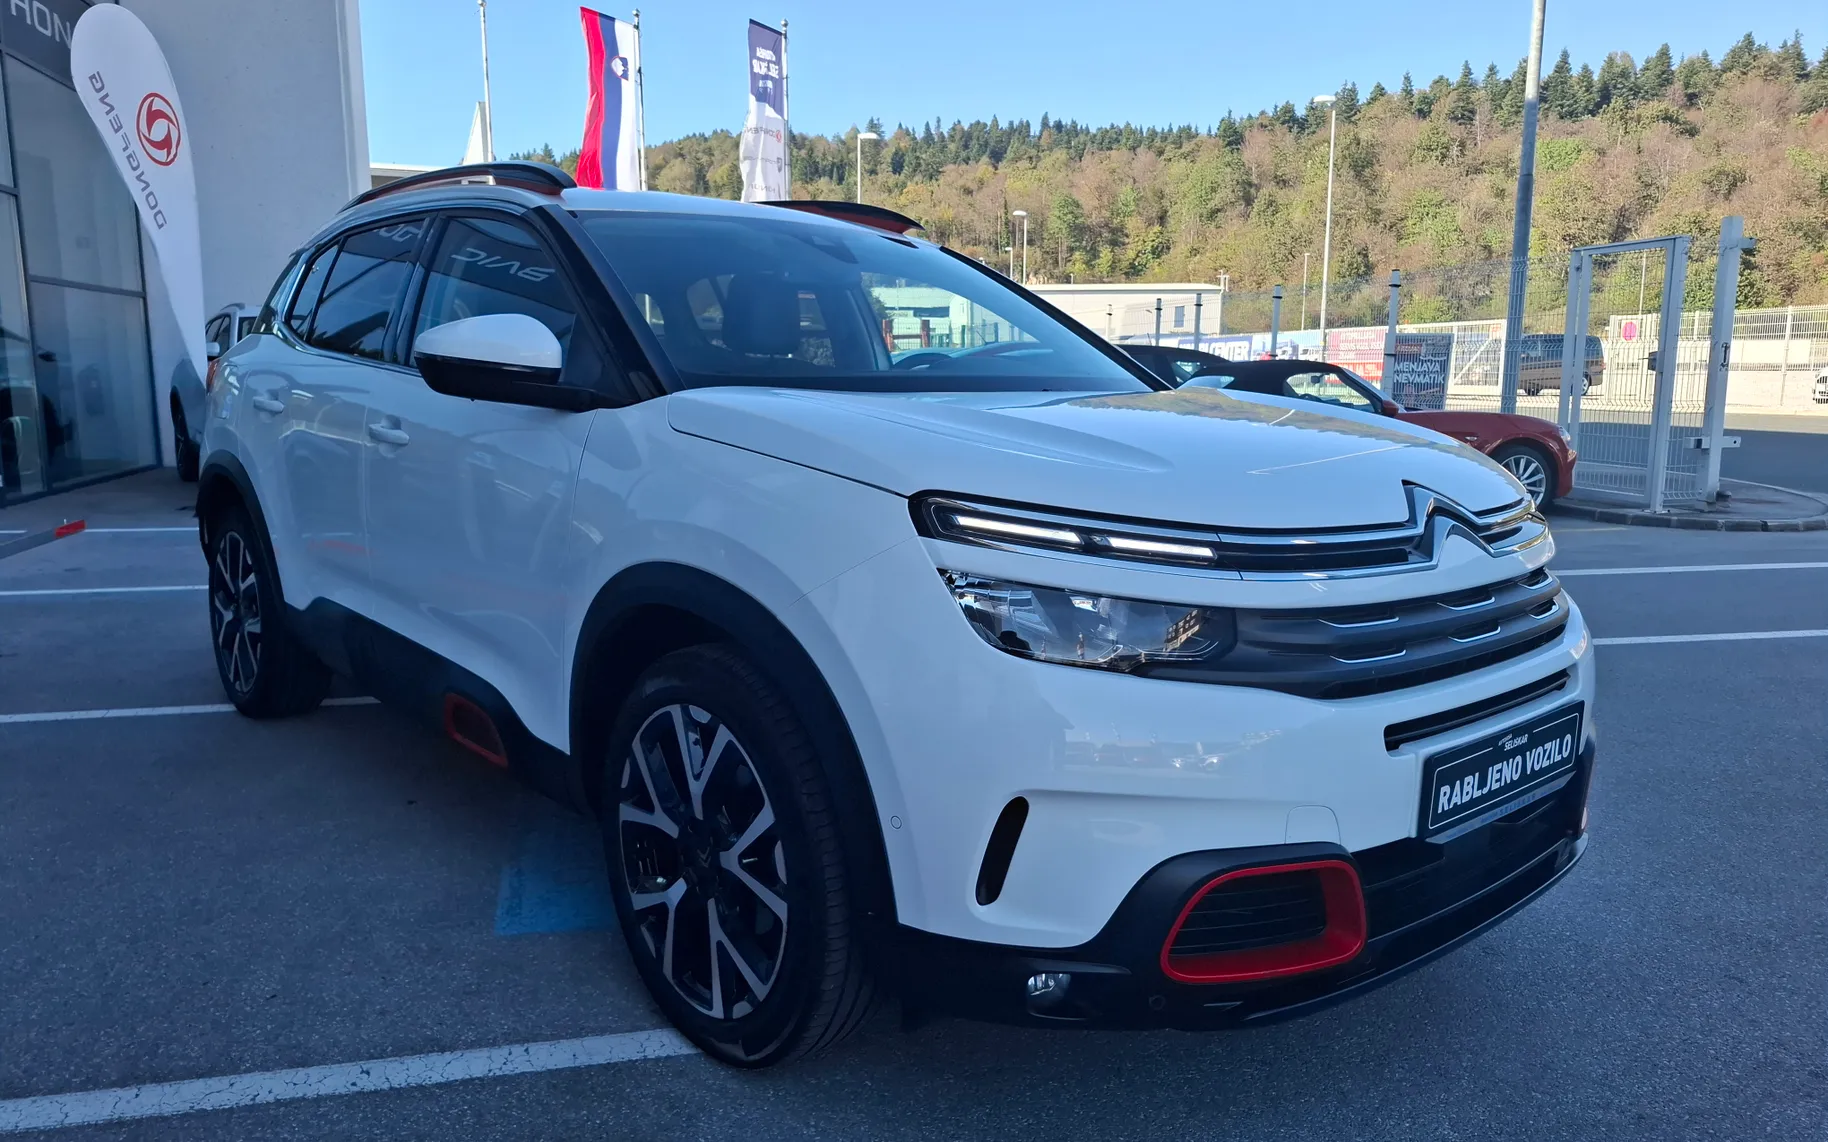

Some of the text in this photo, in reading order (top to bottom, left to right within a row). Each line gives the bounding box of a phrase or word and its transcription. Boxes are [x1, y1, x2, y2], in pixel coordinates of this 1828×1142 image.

[11, 0, 72, 50] HON
[1394, 361, 1441, 372] MENJAVA
[1394, 373, 1445, 384] NEVMATIK
[1437, 733, 1572, 814] RABLJENO VOZILO
